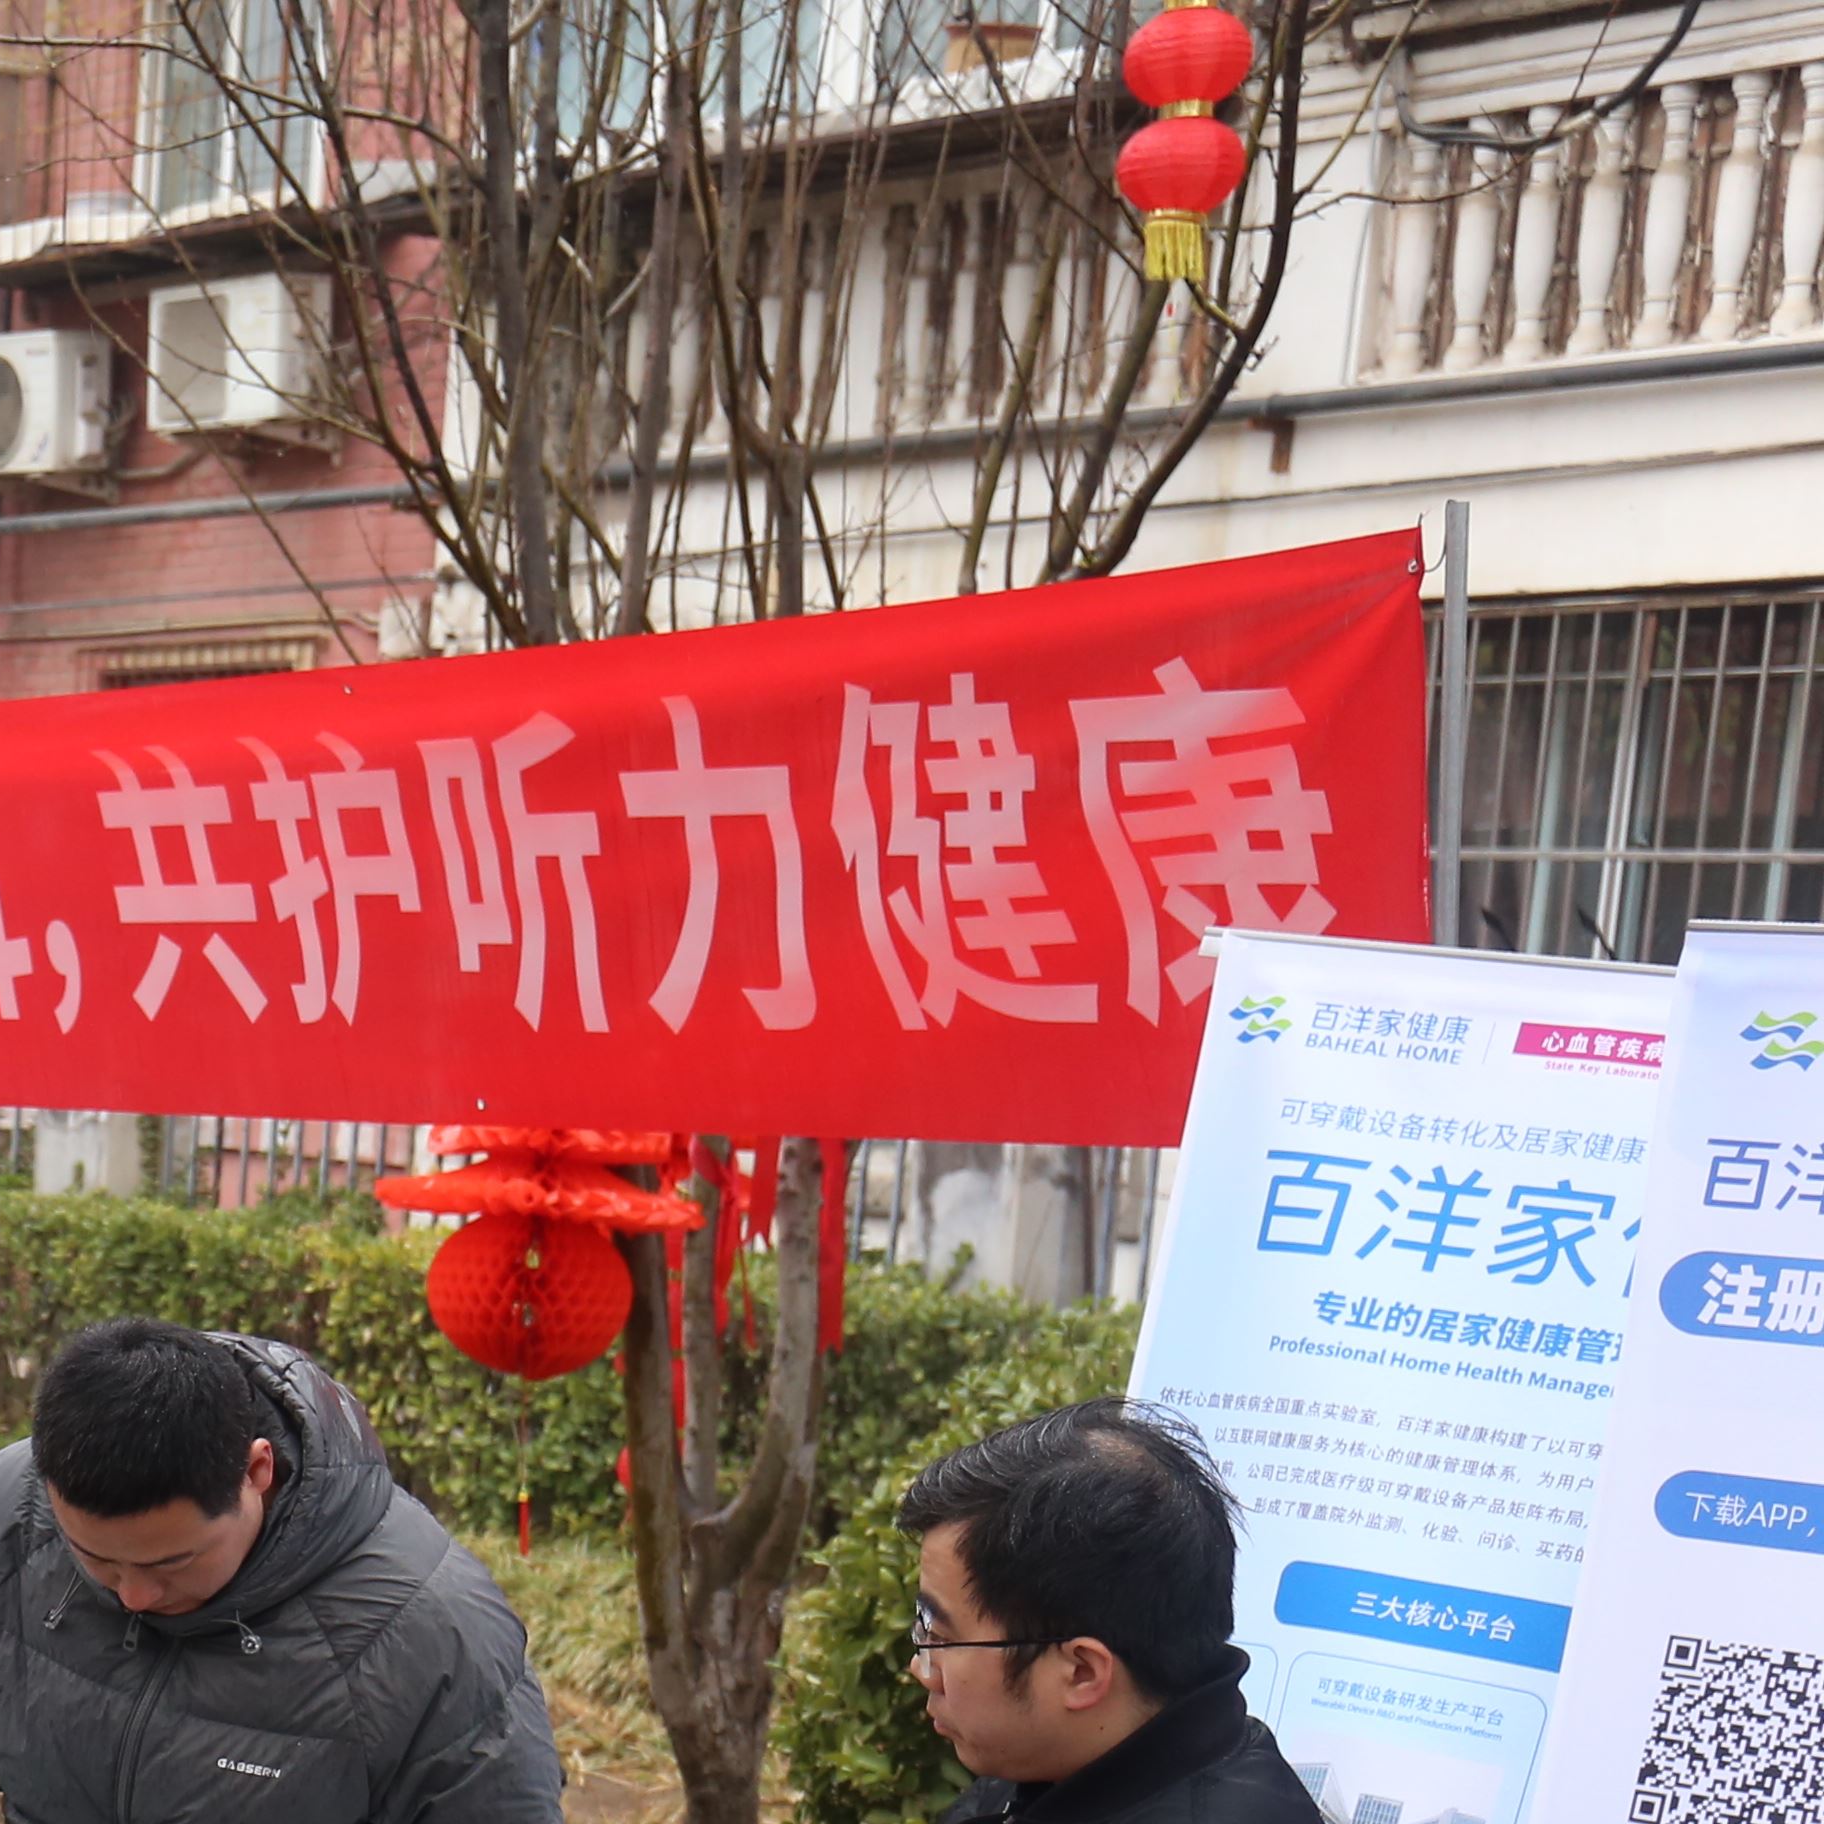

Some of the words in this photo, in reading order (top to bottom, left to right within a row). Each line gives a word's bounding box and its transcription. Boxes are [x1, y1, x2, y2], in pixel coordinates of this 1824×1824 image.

[1310, 1001, 1473, 1046] 百洋家健康
[1305, 1032, 1390, 1060] BAHEAL
[1396, 1043, 1462, 1066] HOME
[1606, 1065, 1659, 1080] Laborato
[1280, 1098, 1648, 1165] 可穿戴设备转化及居家健康
[1269, 1335, 1386, 1366] Professional
[1390, 1351, 1450, 1377] Home
[1455, 1358, 1523, 1386] Health
[1527, 1370, 1614, 1400] Manage
[1350, 1591, 1516, 1642] 三大核心平台
[1317, 1676, 1504, 1726] 可穿戴设备研发生产平台
